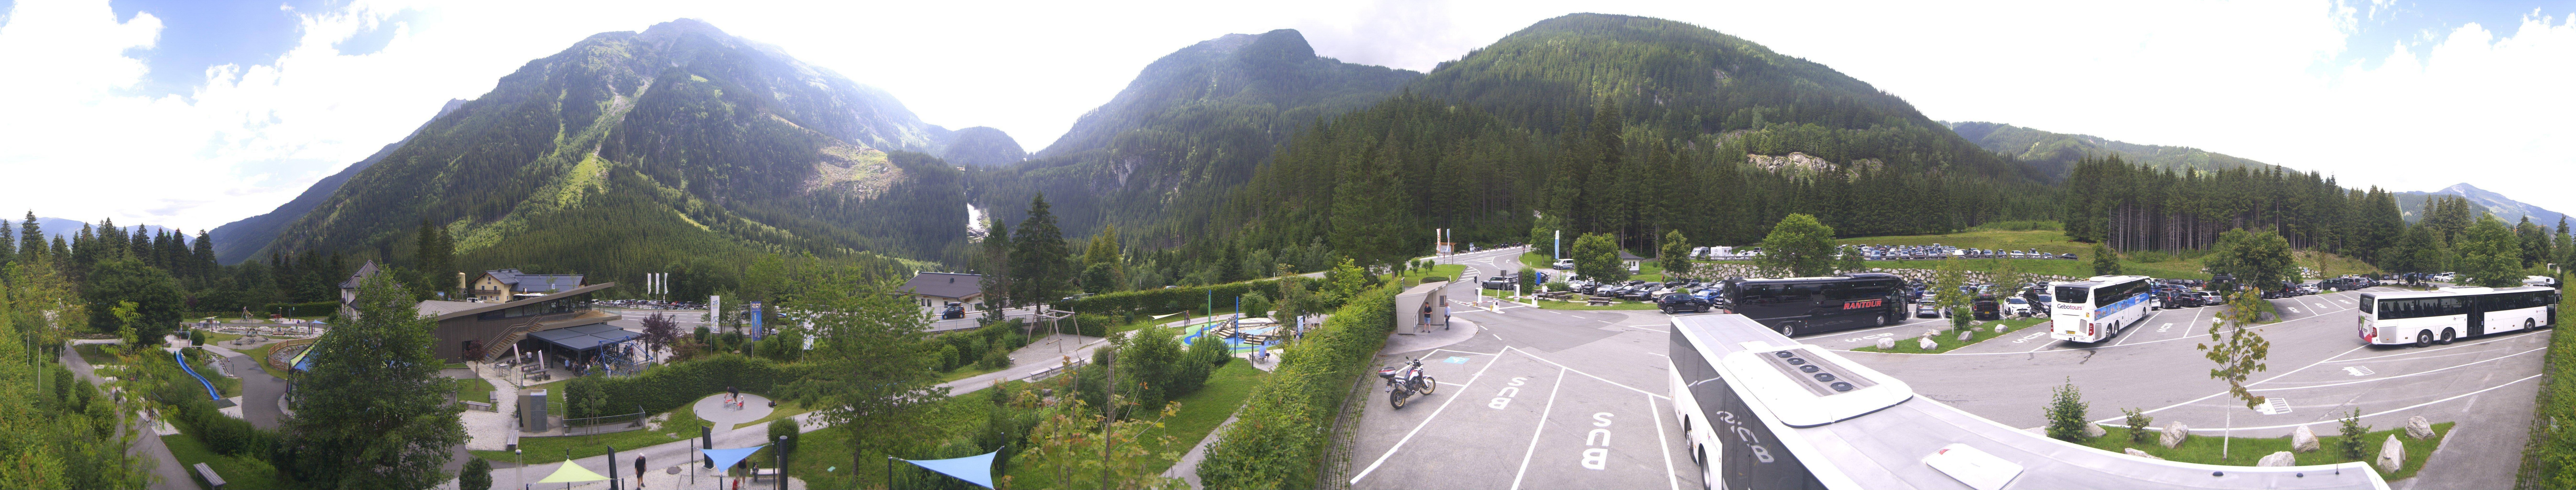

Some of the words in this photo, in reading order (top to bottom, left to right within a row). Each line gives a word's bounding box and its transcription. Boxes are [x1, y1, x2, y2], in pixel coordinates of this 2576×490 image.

[1844, 300, 1882, 310] RANTOUR
[2156, 323, 2173, 332] BUS
[1845, 333, 1894, 342] BUS
[2012, 332, 2046, 343] BUS
[1488, 377, 1528, 410] BUS
[1581, 412, 1614, 470] BUS
